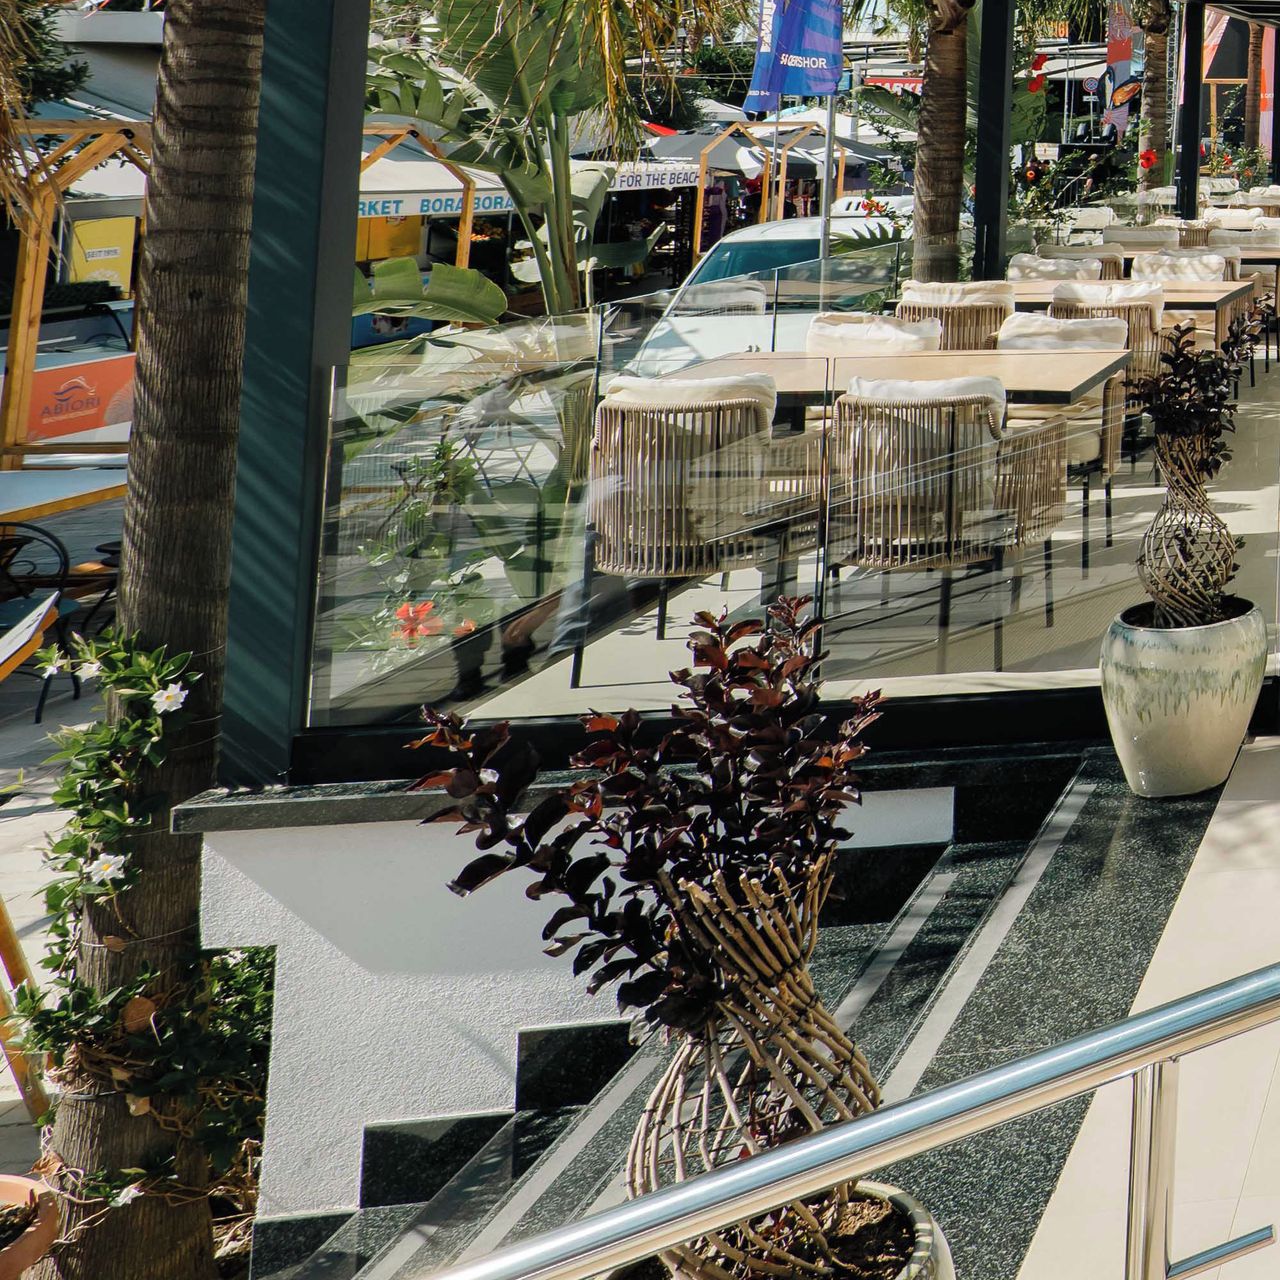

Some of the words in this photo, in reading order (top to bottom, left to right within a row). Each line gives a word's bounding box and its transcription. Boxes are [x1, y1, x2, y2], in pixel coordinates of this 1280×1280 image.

[620, 174, 642, 188] FOR
[645, 173, 667, 187] THE
[358, 199, 404, 216] RKET
[419, 197, 464, 213] BORA
[473, 195, 515, 210] BORA
